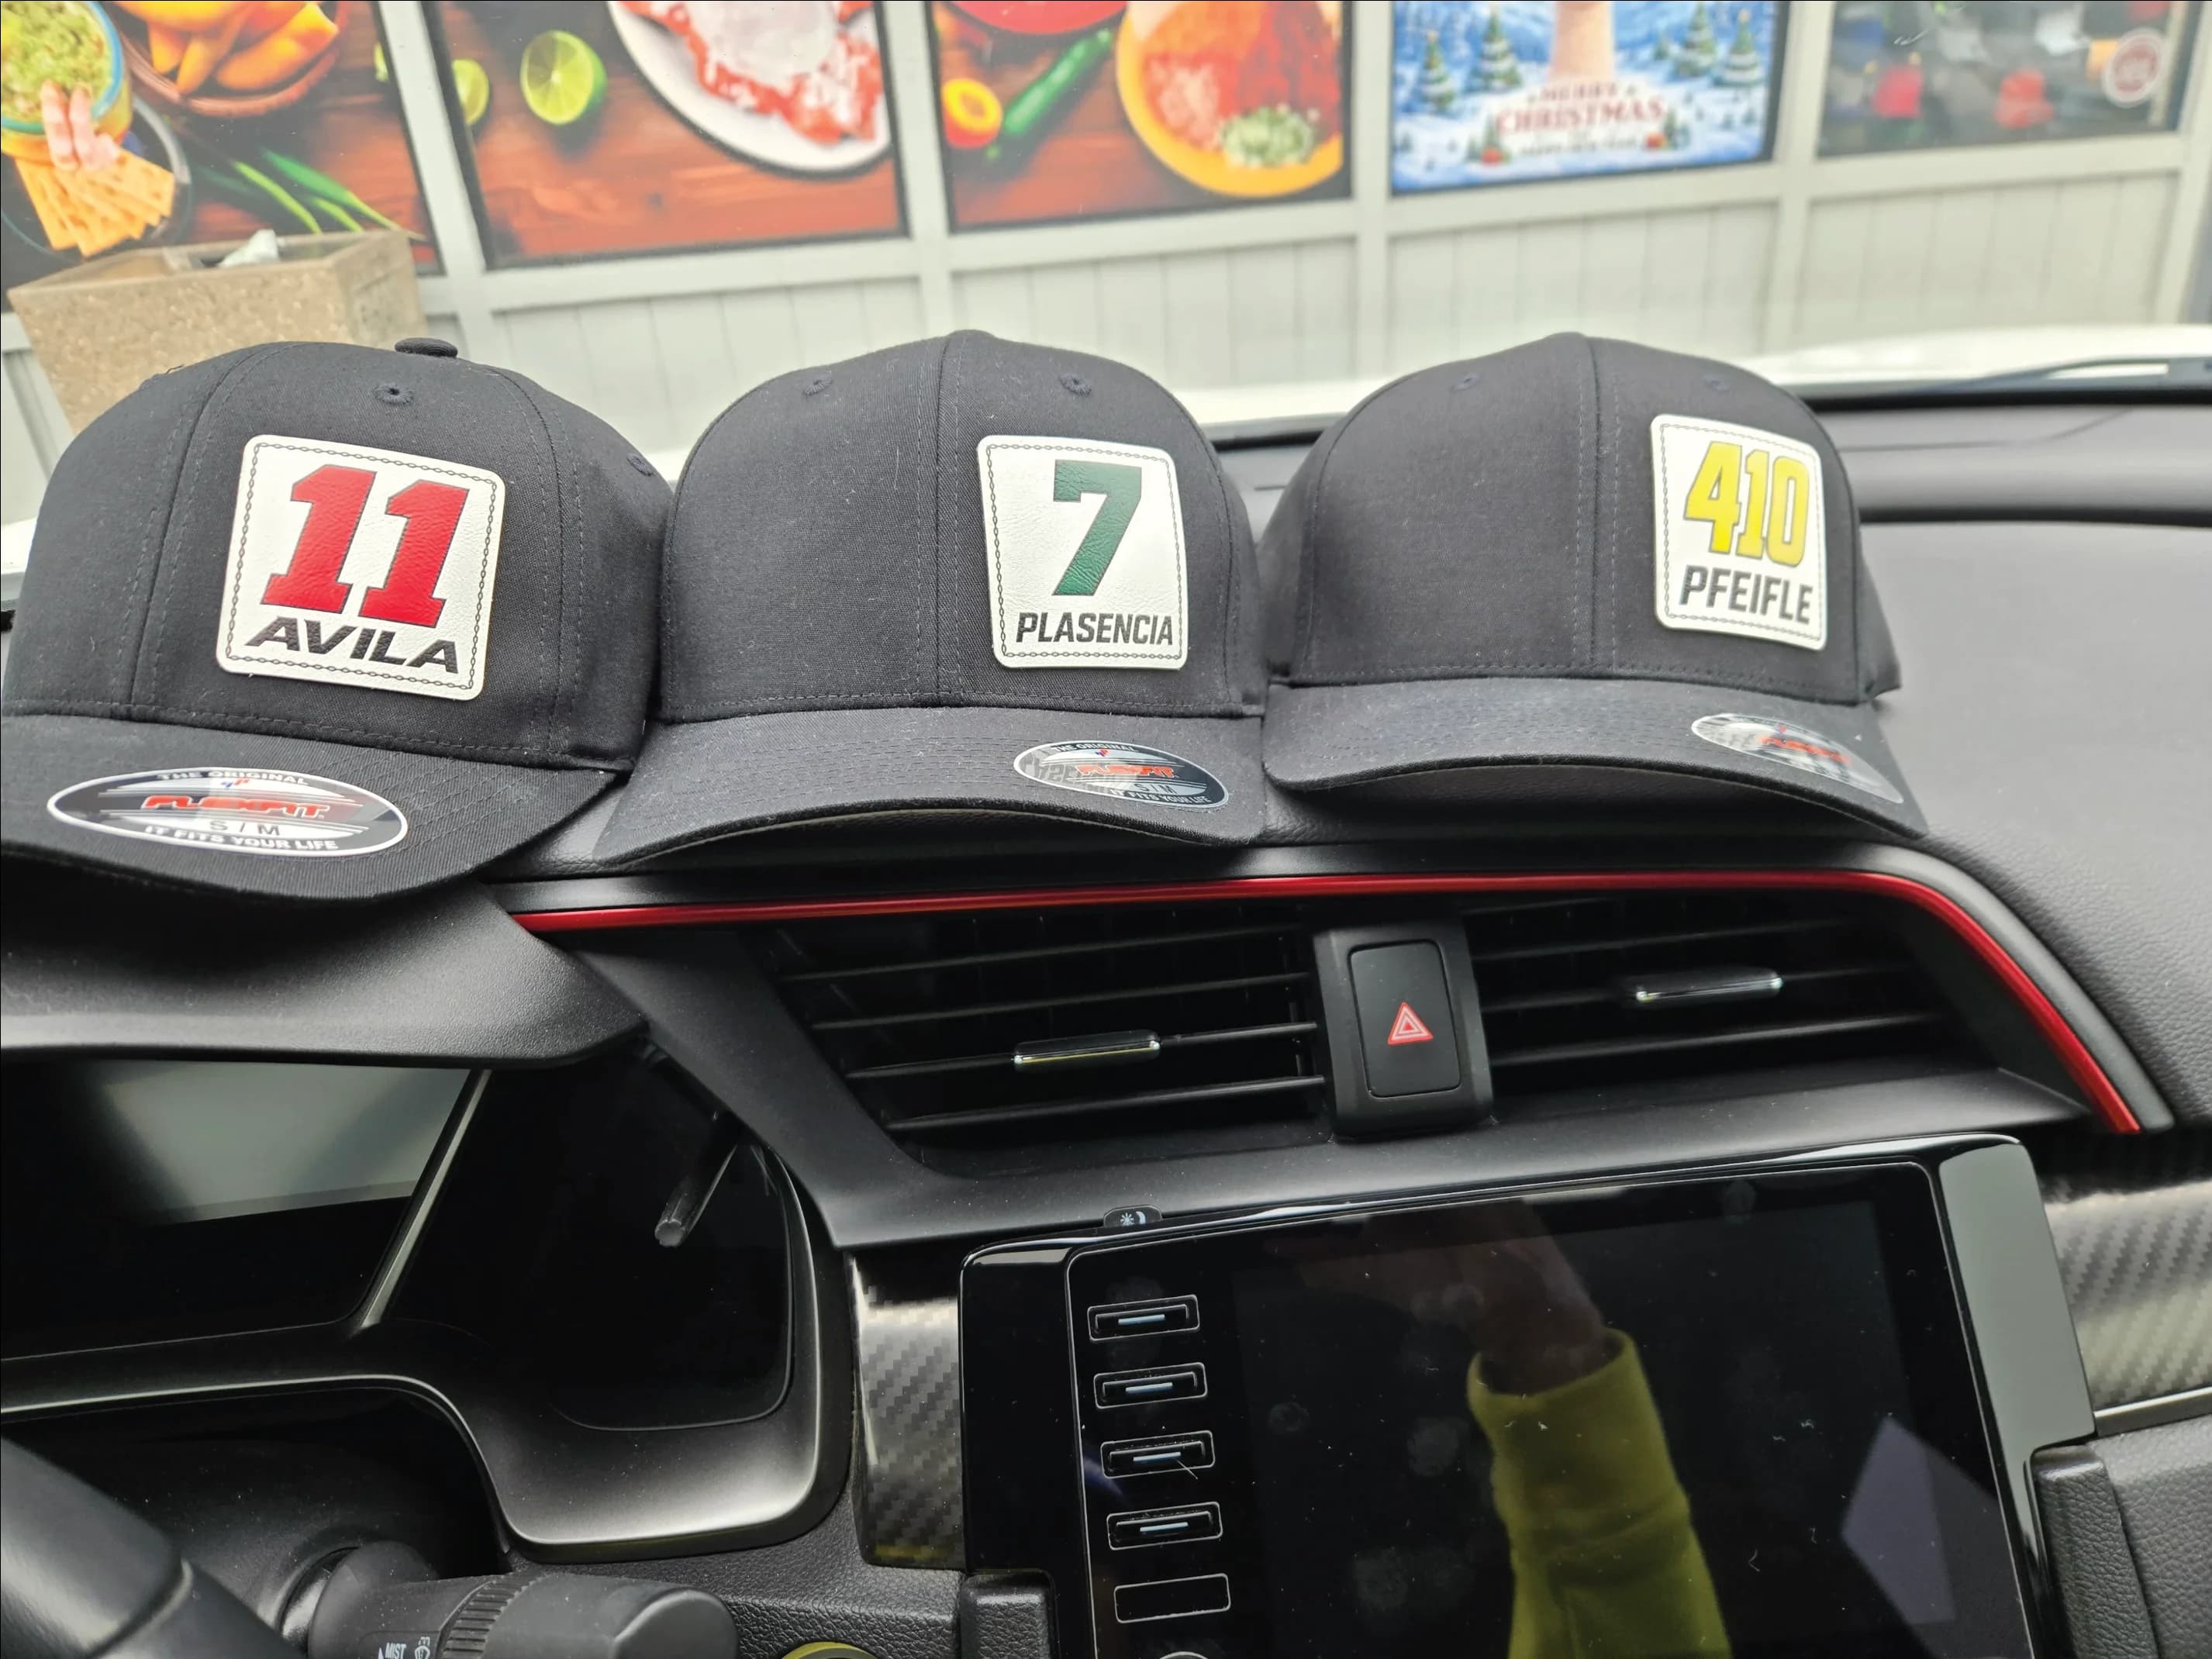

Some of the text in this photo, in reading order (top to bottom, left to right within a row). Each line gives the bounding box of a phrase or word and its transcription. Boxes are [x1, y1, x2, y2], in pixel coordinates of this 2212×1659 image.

[1496, 98, 1665, 133] CHRISTMAS
[1683, 440, 1810, 567] 410
[1051, 459, 1142, 596] 7
[260, 464, 470, 629] 11
[1679, 564, 1813, 624] PFEIFLE
[244, 616, 458, 674] AVILA
[1016, 612, 1172, 645] PLASENCIA
[1078, 743, 1140, 753] ORIGINAL
[157, 771, 309, 786] THE ORIGINAL
[1125, 791, 1161, 801] FITS
[1162, 794, 1192, 803] YOUR
[1189, 795, 1212, 804] LIFE
[145, 825, 339, 851] IT FITS YOUR LIFE
[385, 1641, 407, 1659] MIST
